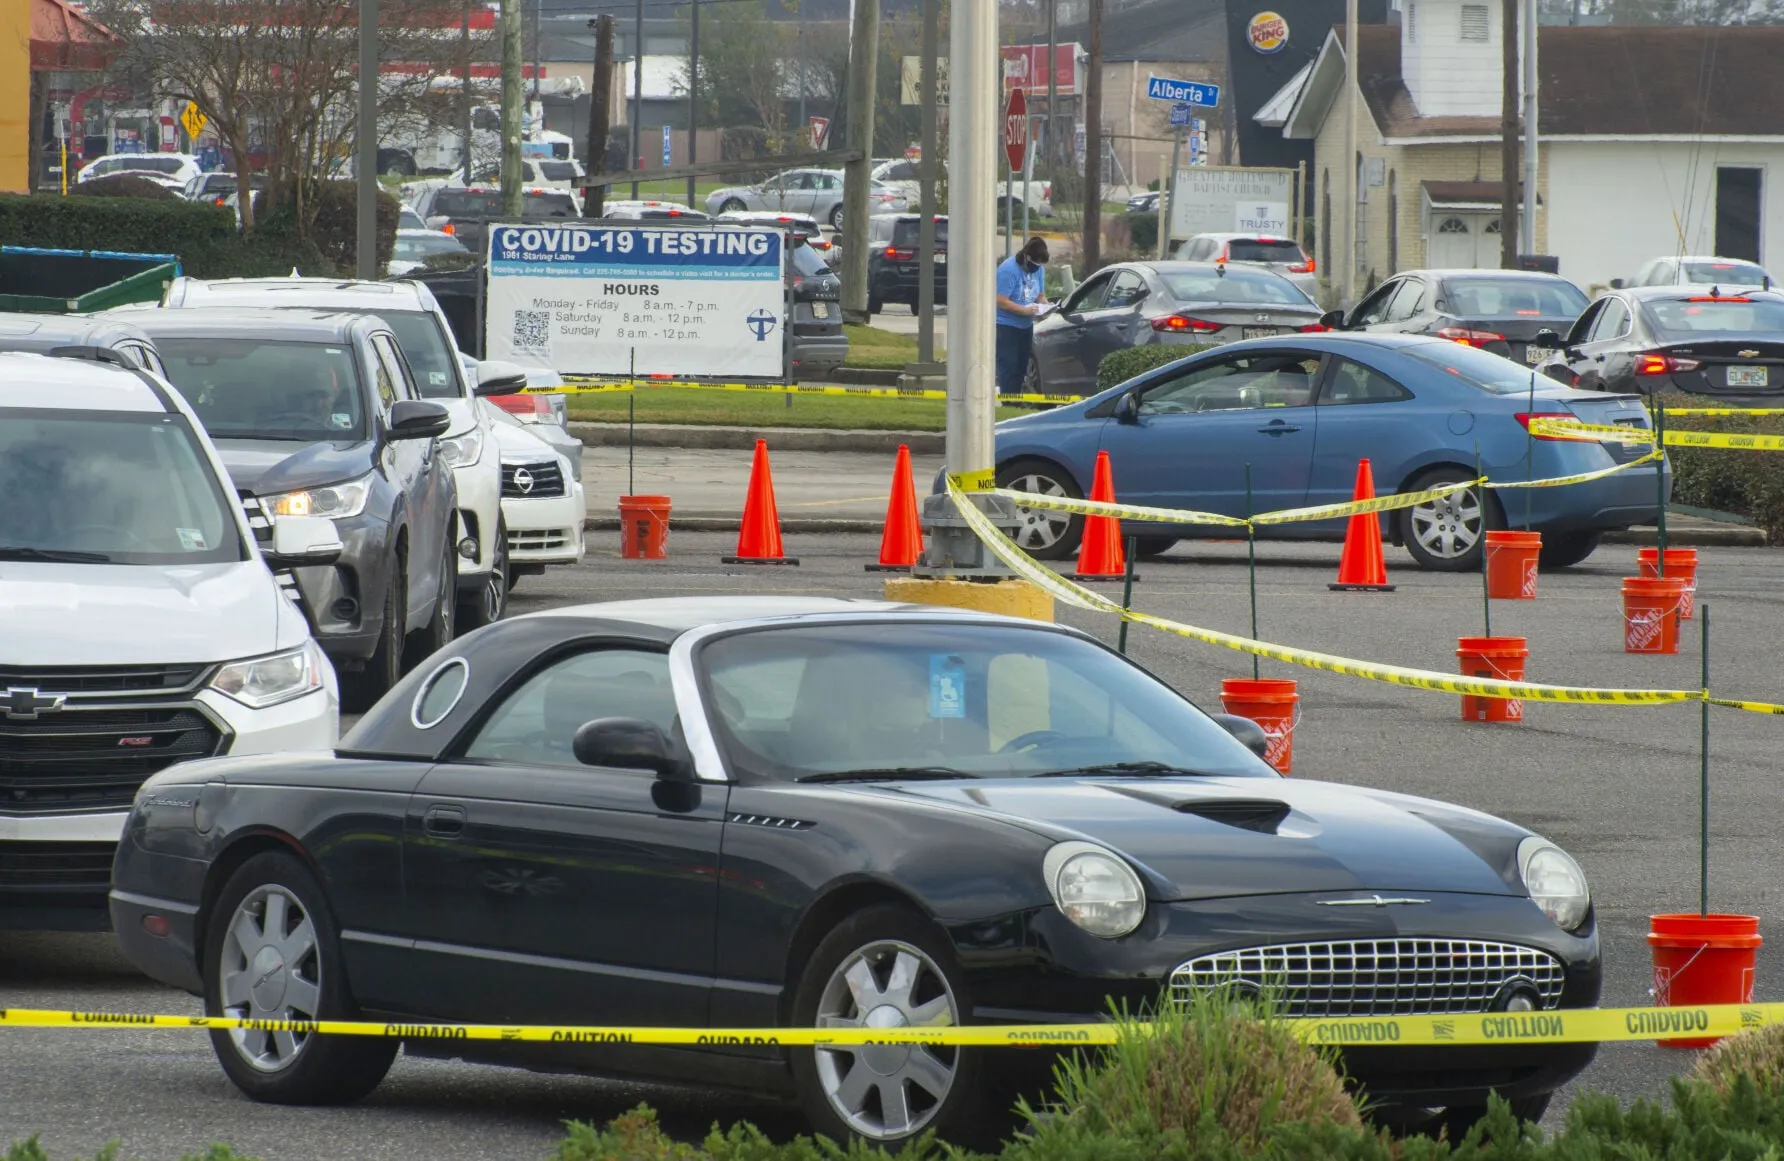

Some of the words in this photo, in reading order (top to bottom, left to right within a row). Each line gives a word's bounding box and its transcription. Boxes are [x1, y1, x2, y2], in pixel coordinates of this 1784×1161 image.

[1253, 27, 1285, 45] KING
[1151, 81, 1203, 102] Alberta
[1208, 88, 1214, 97] Dr
[1007, 115, 1026, 145] STOP
[1240, 220, 1284, 229] TRUSTY
[502, 229, 634, 253] COVID-19
[643, 232, 769, 255] TESTING
[522, 252, 553, 261] Staring
[554, 252, 576, 261] Lane
[604, 284, 660, 296] HOURS
[533, 299, 576, 311] Monday
[586, 300, 619, 311] Friday
[643, 300, 650, 309] 8
[688, 301, 694, 310] 7
[697, 303, 720, 312] p.m.
[556, 312, 602, 323] Saturday
[623, 313, 629, 322] 8
[668, 314, 680, 323] 12
[683, 315, 706, 325] p.m.
[560, 326, 600, 337] Sunday
[617, 328, 624, 338] 8
[664, 329, 674, 339] 12
[678, 330, 700, 340] p.m.
[119, 737, 152, 746] RS
